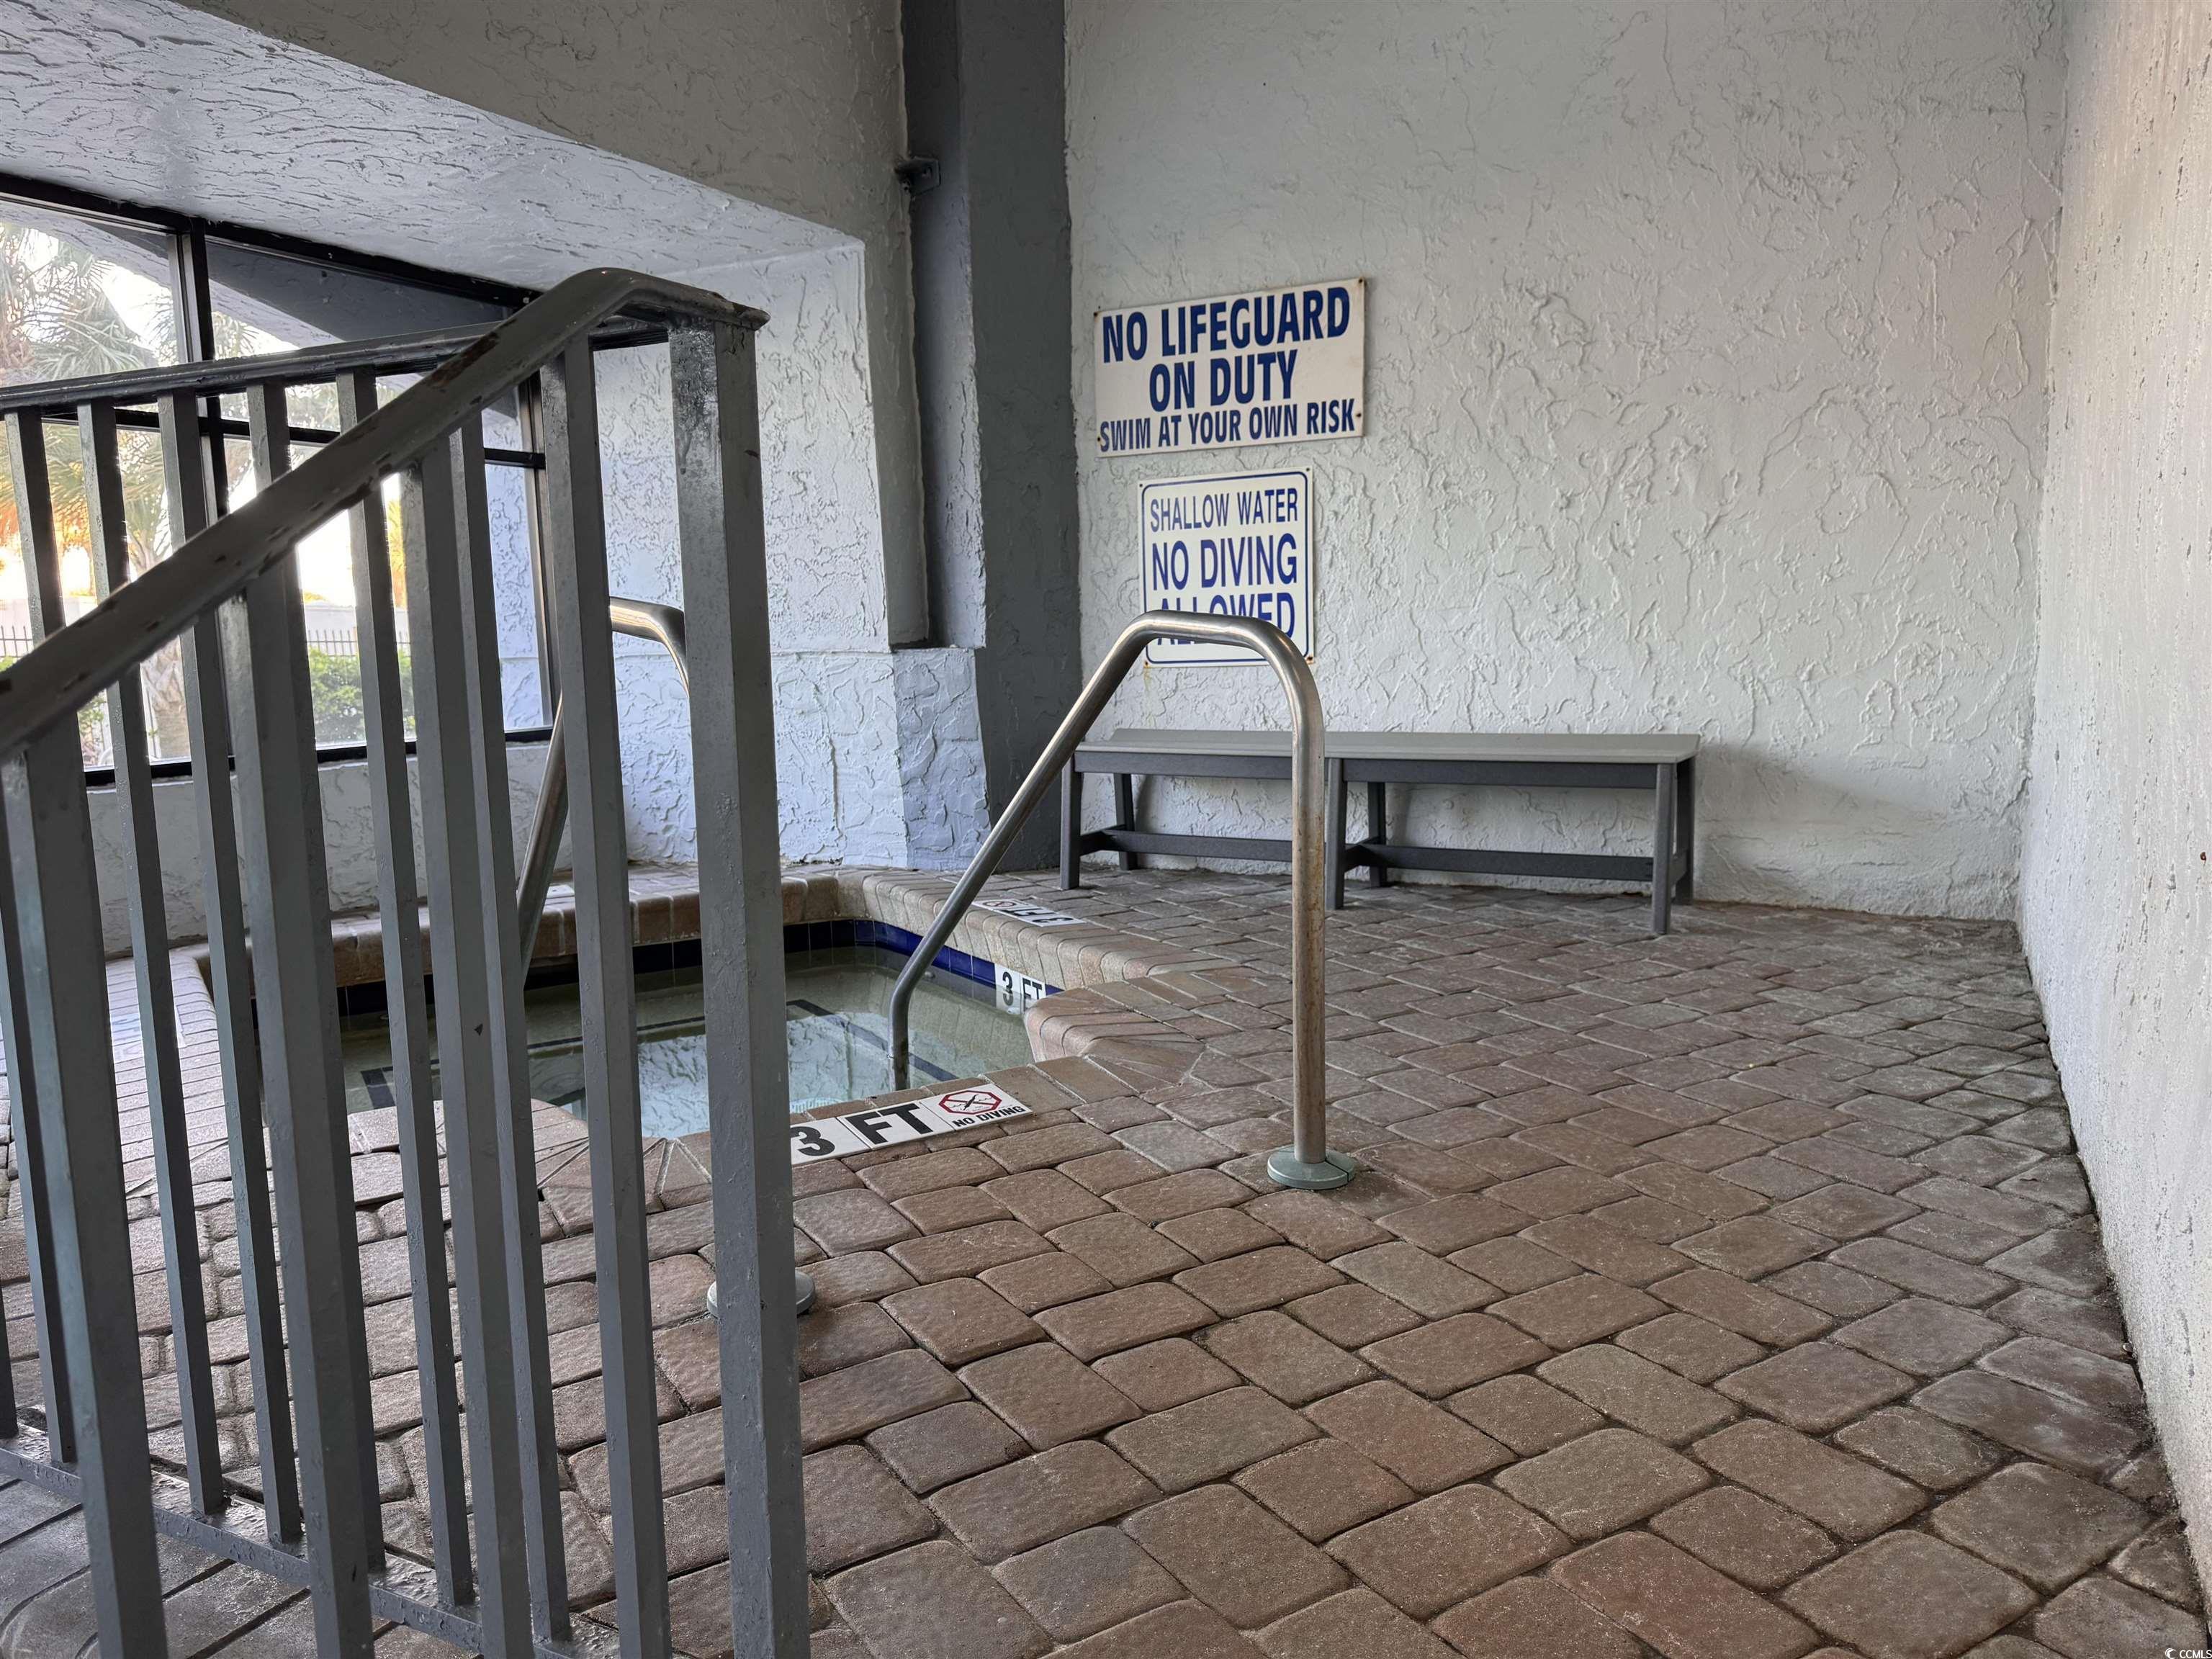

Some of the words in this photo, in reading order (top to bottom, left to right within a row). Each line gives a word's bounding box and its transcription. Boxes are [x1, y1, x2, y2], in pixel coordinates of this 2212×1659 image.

[1102, 311, 1148, 363] NO
[1161, 287, 1350, 356] LIFEGUARD
[1148, 361, 1195, 412] ON
[1210, 349, 1299, 406] DUTY
[1100, 418, 1151, 452] SWIM
[1158, 415, 1182, 446] AT
[1188, 408, 1241, 444] YOUR
[1249, 405, 1298, 439] OWN
[1306, 399, 1355, 434] RISK
[1150, 493, 1230, 532] SHALLOW
[1237, 487, 1298, 525] WATER
[1152, 540, 1189, 590] NO
[1201, 533, 1298, 588] DIVING
[791, 1126, 835, 1156] 3
[845, 1102, 934, 1145] FT
[951, 1117, 976, 1128] NO
[976, 1105, 1027, 1121] DIVING
